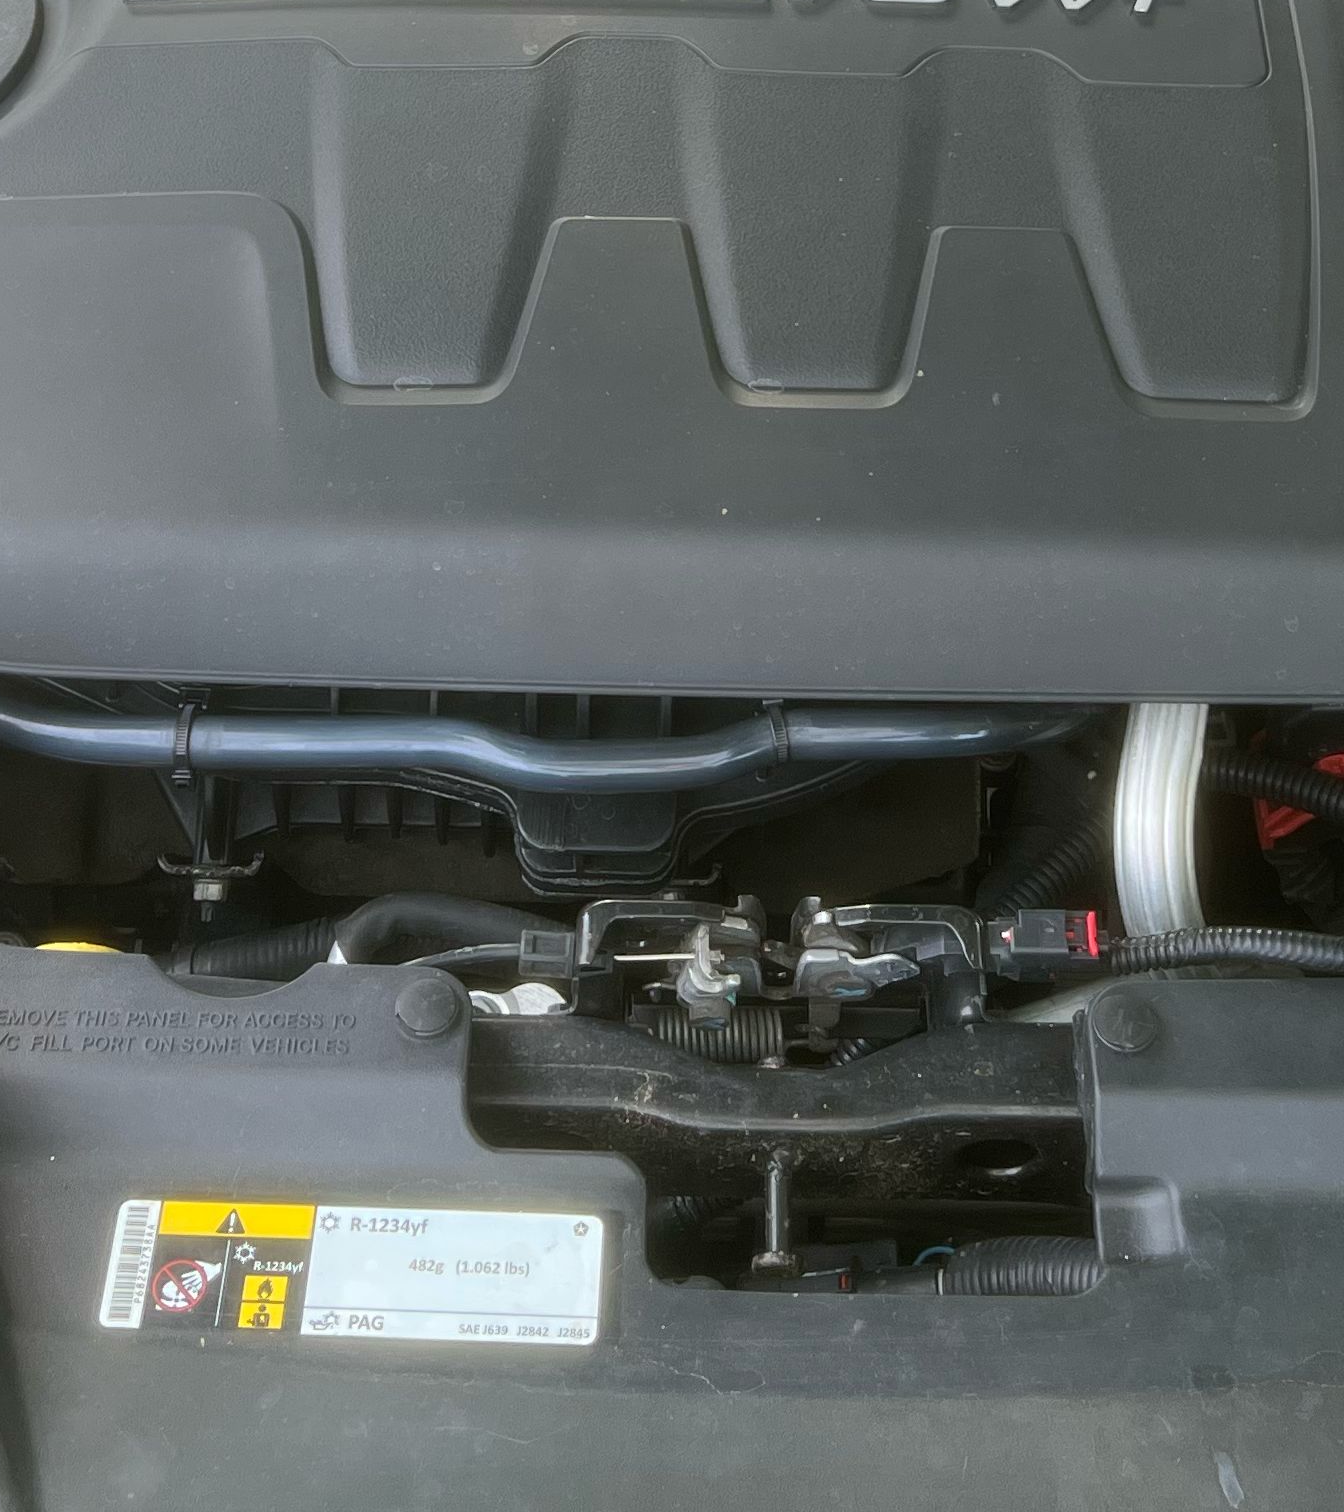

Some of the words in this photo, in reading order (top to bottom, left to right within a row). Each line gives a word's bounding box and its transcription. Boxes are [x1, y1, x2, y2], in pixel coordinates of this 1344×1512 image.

[75, 1009, 120, 1028] THIS
[125, 1010, 190, 1029] PANEL
[198, 1011, 238, 1029] FOR
[244, 1010, 324, 1030] ACCESS
[334, 1012, 357, 1031] TO
[30, 1033, 72, 1053] FILL
[81, 1035, 137, 1054] PORT
[144, 1035, 175, 1054] ON
[181, 1036, 242, 1055] SOME
[250, 1036, 351, 1056] VEHICLES
[350, 1215, 428, 1237] R-1234yf
[253, 1260, 304, 1274] R-1234yf
[408, 1258, 445, 1275] 482g
[455, 1260, 501, 1276] (1.062
[504, 1260, 531, 1278] lbs)
[348, 1314, 385, 1333] PAG
[458, 1323, 481, 1336] SAE
[482, 1324, 509, 1337] J639
[516, 1326, 550, 1338] J2842
[557, 1327, 591, 1340] J2845
